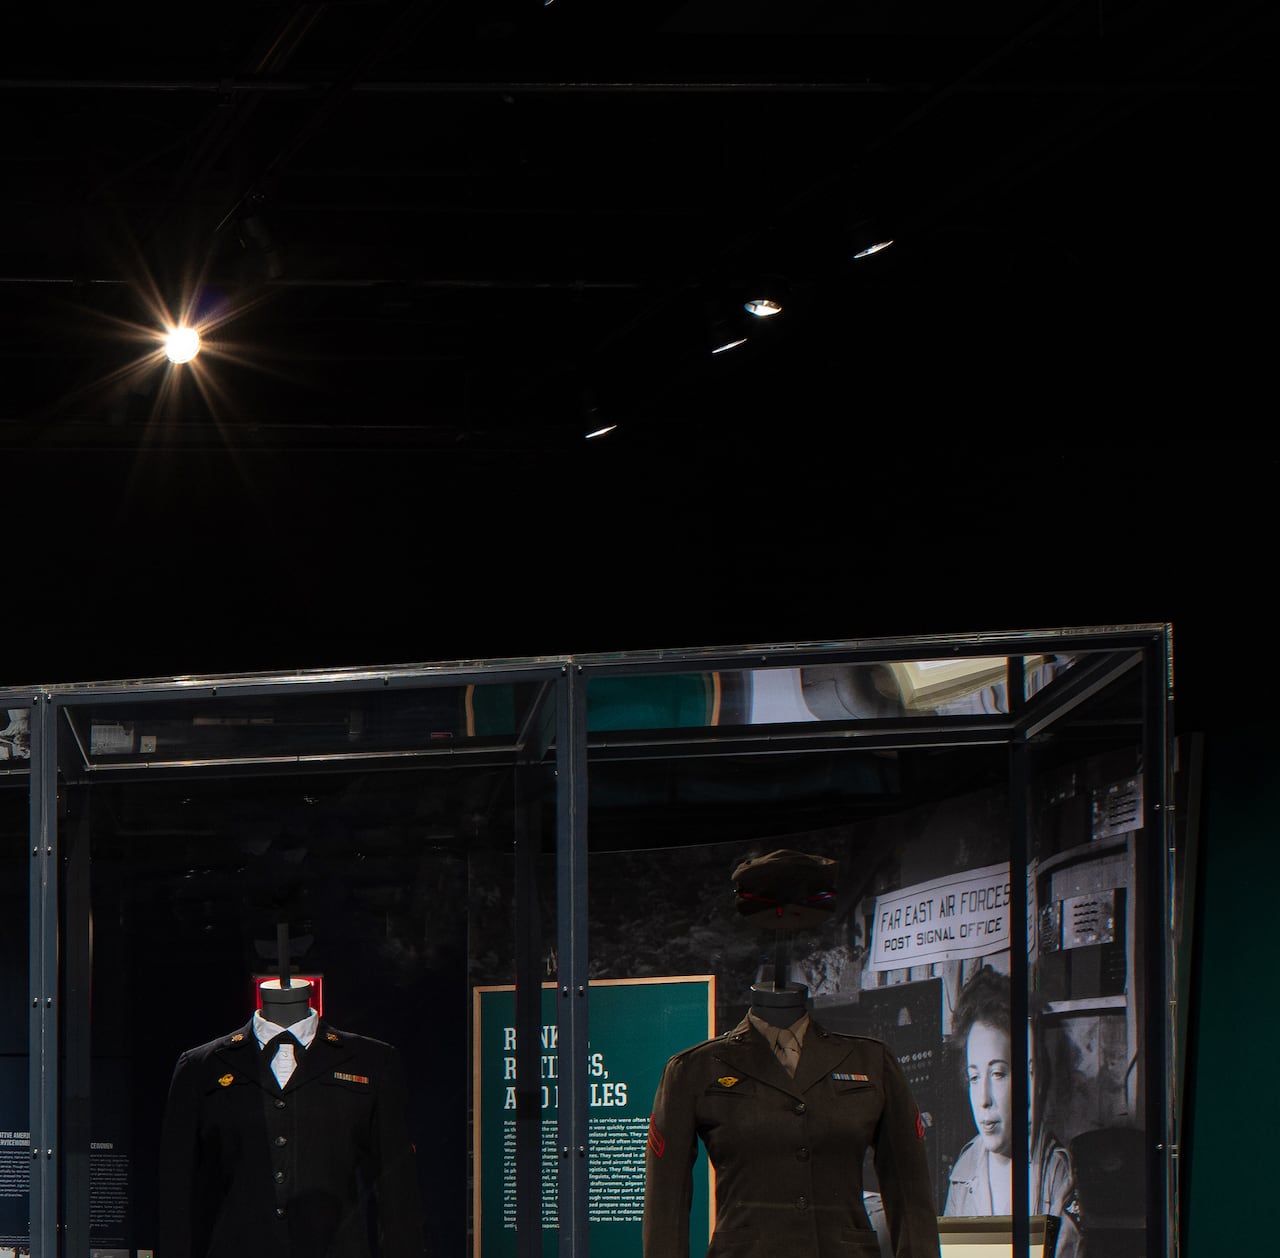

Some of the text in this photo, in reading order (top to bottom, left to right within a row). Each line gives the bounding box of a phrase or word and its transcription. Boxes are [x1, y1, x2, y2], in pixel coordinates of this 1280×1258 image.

[880, 883, 1011, 932] FAR EAST AIR FORCES
[884, 917, 1002, 953] POST SIGNAL OFFICE
